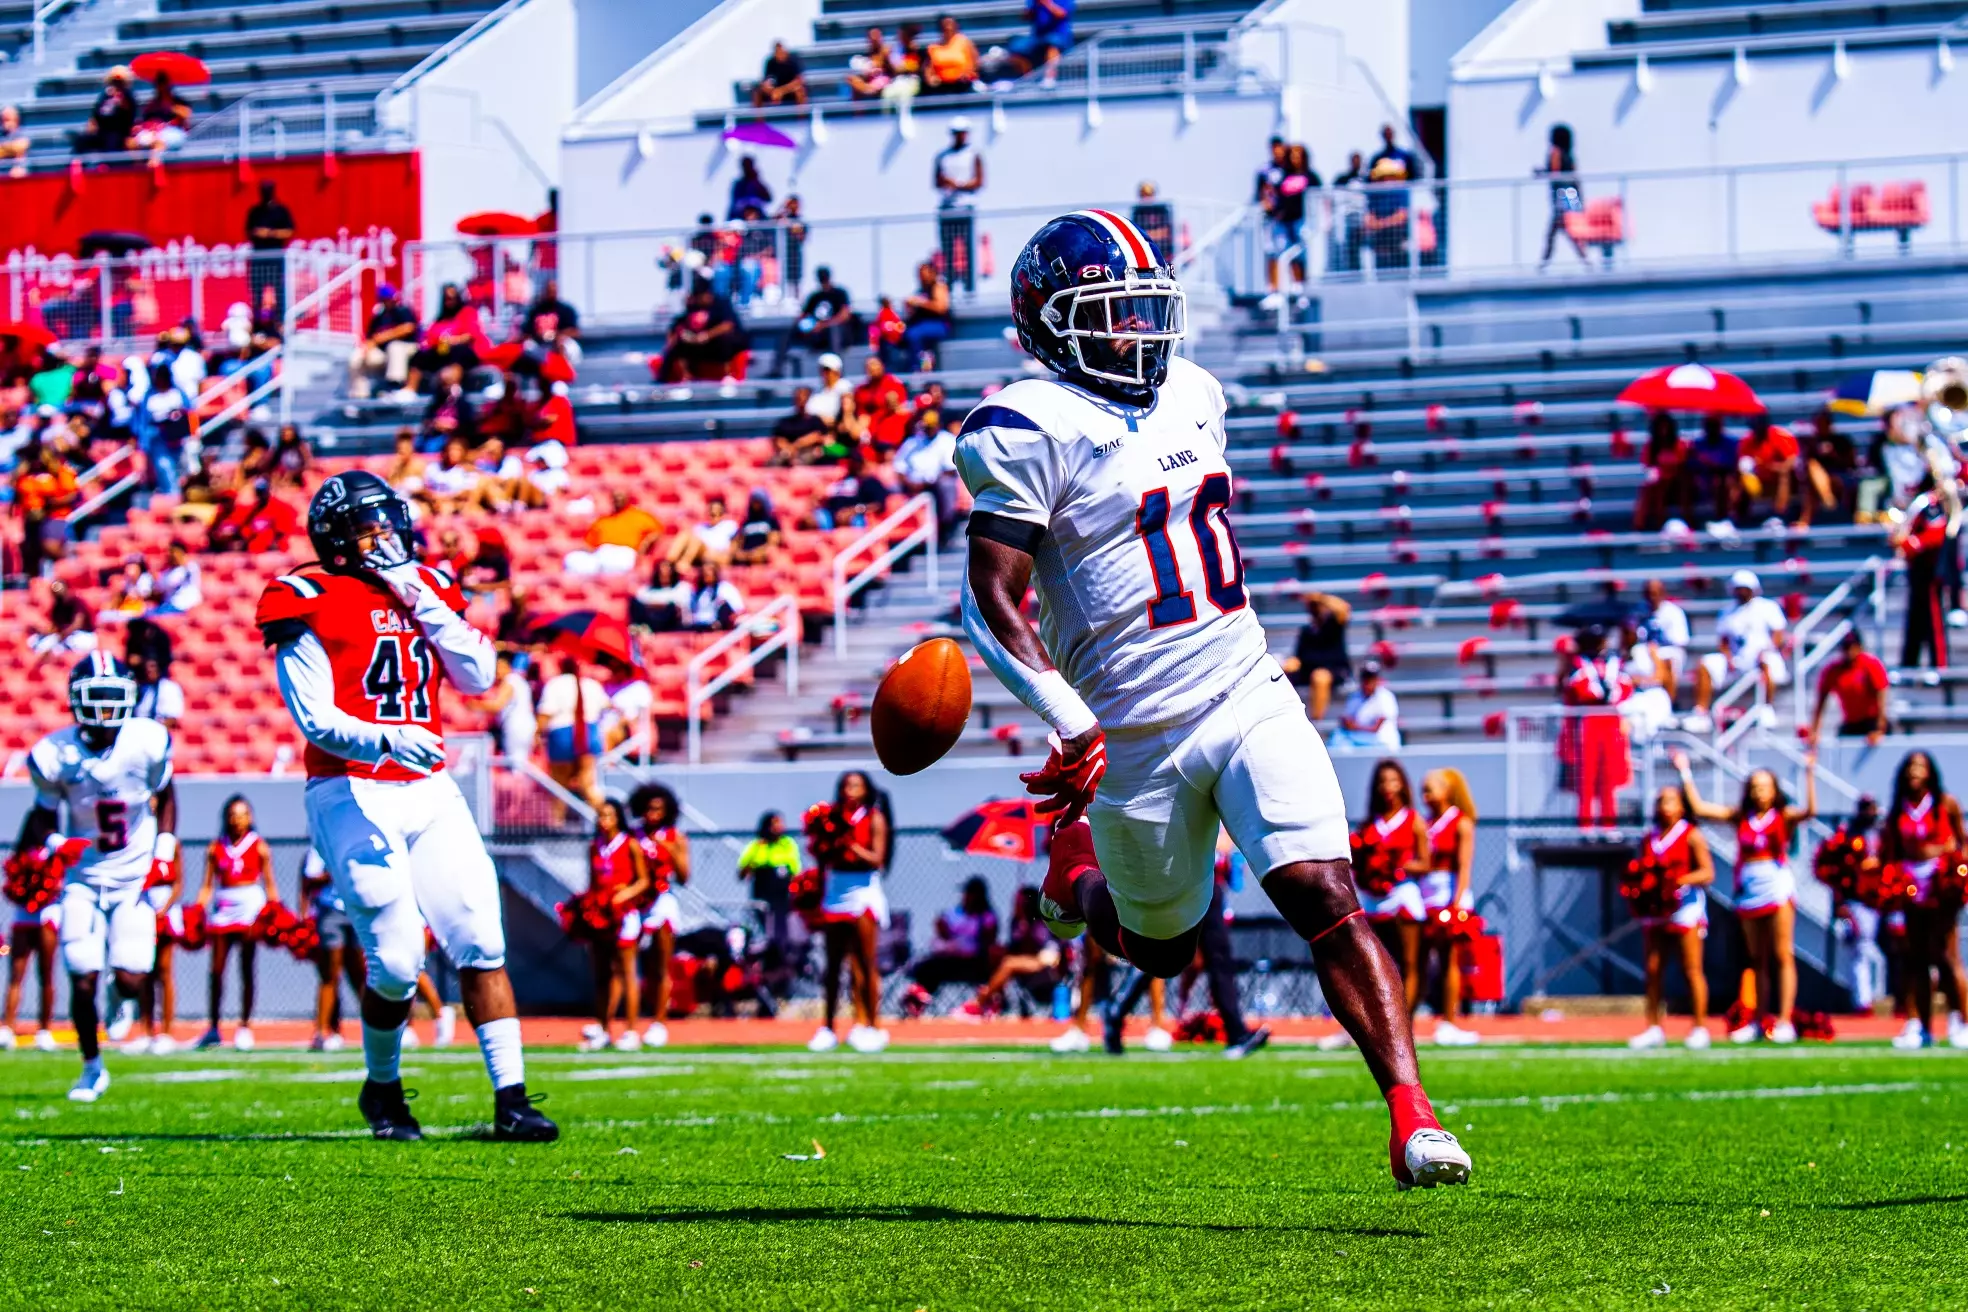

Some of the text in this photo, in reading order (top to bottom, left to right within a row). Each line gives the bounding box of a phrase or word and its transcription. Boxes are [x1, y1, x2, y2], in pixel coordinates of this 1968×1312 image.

[8, 225, 397, 287] the nther spirit
[1092, 437, 1124, 459] SIAC
[1157, 450, 1198, 472] LANE
[1136, 472, 1247, 630] 10
[362, 636, 431, 722] 41
[95, 800, 127, 854] 5
